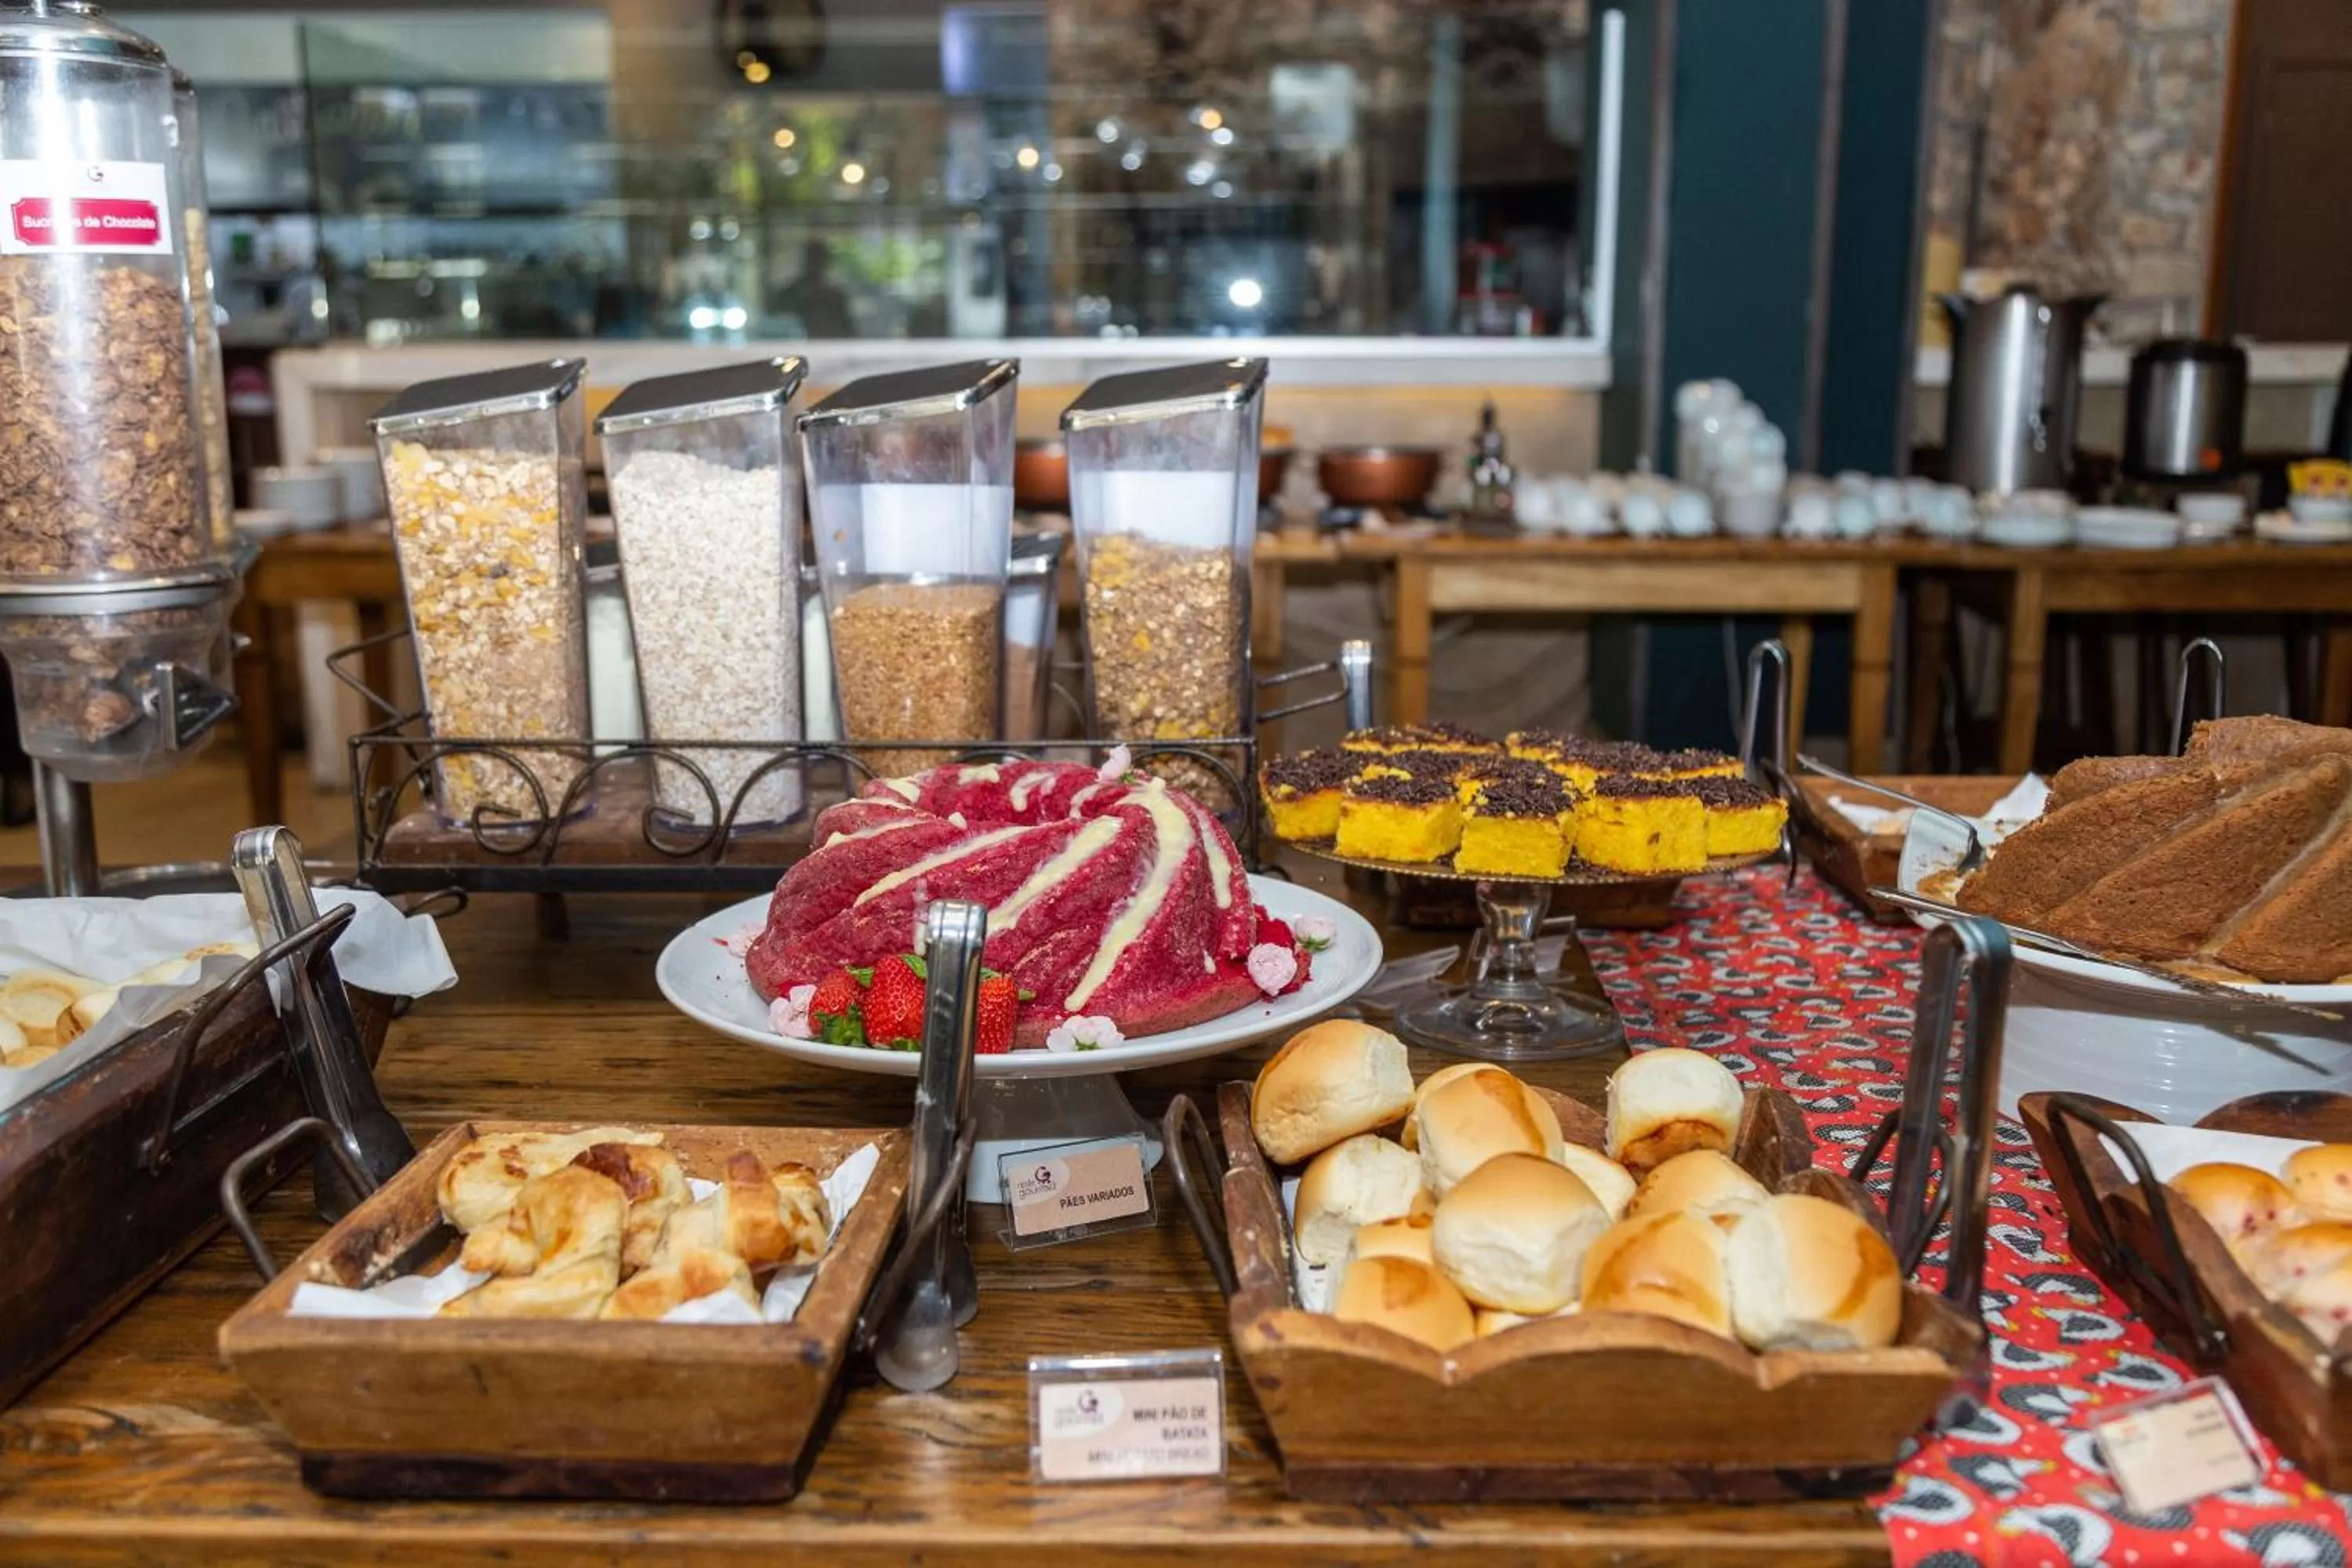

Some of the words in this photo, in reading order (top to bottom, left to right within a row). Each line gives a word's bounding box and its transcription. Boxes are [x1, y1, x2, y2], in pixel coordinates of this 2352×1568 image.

[22, 216, 82, 228] Sucrs
[84, 215, 100, 227] de
[103, 215, 155, 229] Chocolate
[1059, 1196, 1086, 1210] PÃES
[1088, 1185, 1135, 1205] VARIADOS
[1133, 1407, 1158, 1423] MINI
[1162, 1403, 1189, 1420] PÃO
[1192, 1406, 1206, 1419] DE
[1161, 1427, 1208, 1441] BATATA
